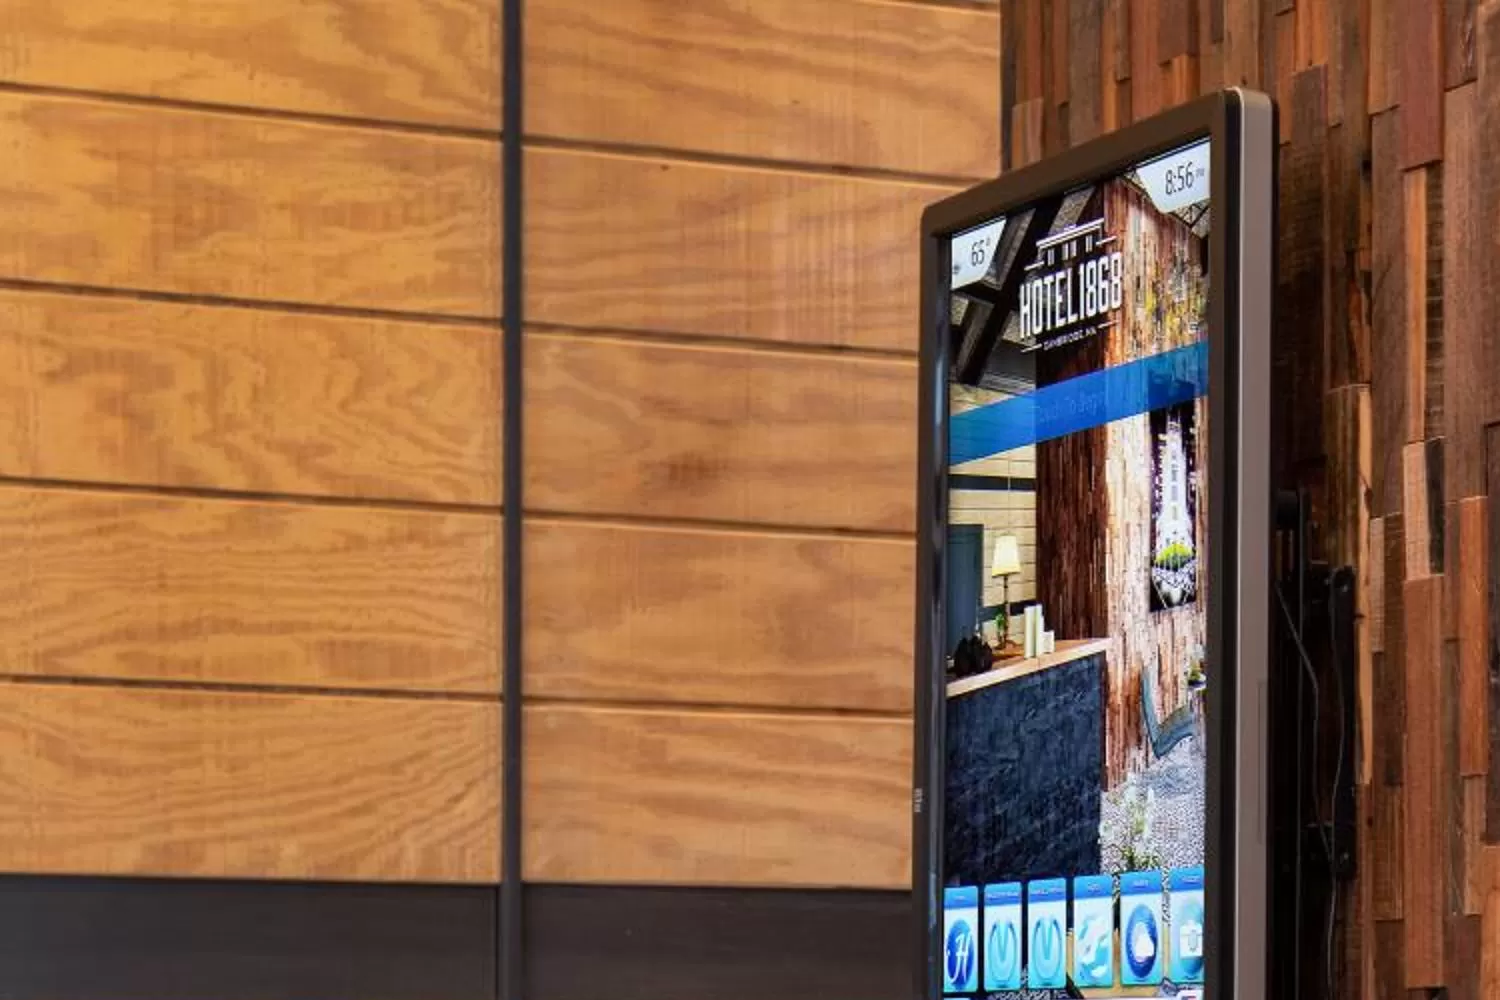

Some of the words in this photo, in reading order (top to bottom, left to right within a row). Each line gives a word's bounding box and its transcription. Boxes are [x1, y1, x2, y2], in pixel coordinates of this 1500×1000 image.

[1165, 161, 1195, 196] 8:56
[1019, 266, 1080, 339] HOTEL
[1079, 252, 1122, 321] 1868
